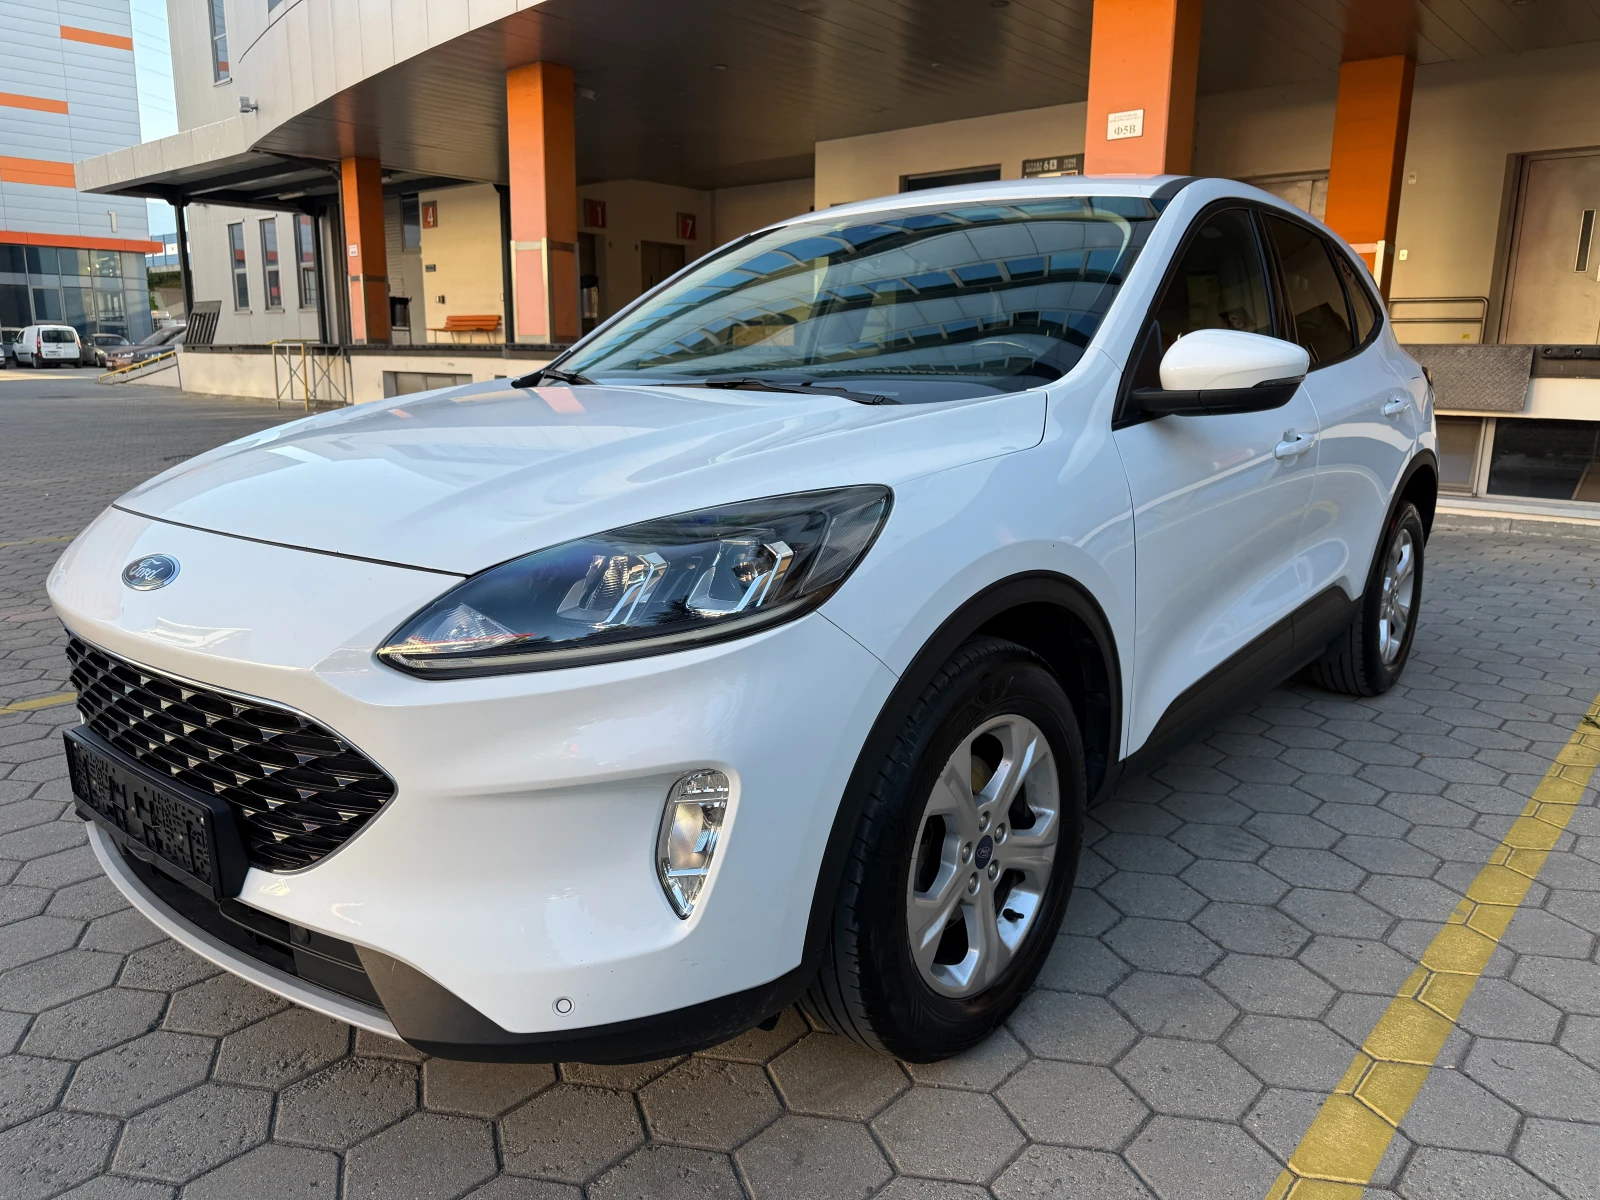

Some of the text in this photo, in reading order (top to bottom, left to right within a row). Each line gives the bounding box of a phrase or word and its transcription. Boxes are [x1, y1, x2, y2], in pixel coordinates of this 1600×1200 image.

[1043, 160, 1049, 170] 6
[108, 210, 117, 233] 1
[427, 207, 434, 226] 4
[597, 206, 602, 226] 1
[686, 219, 693, 238] 7
